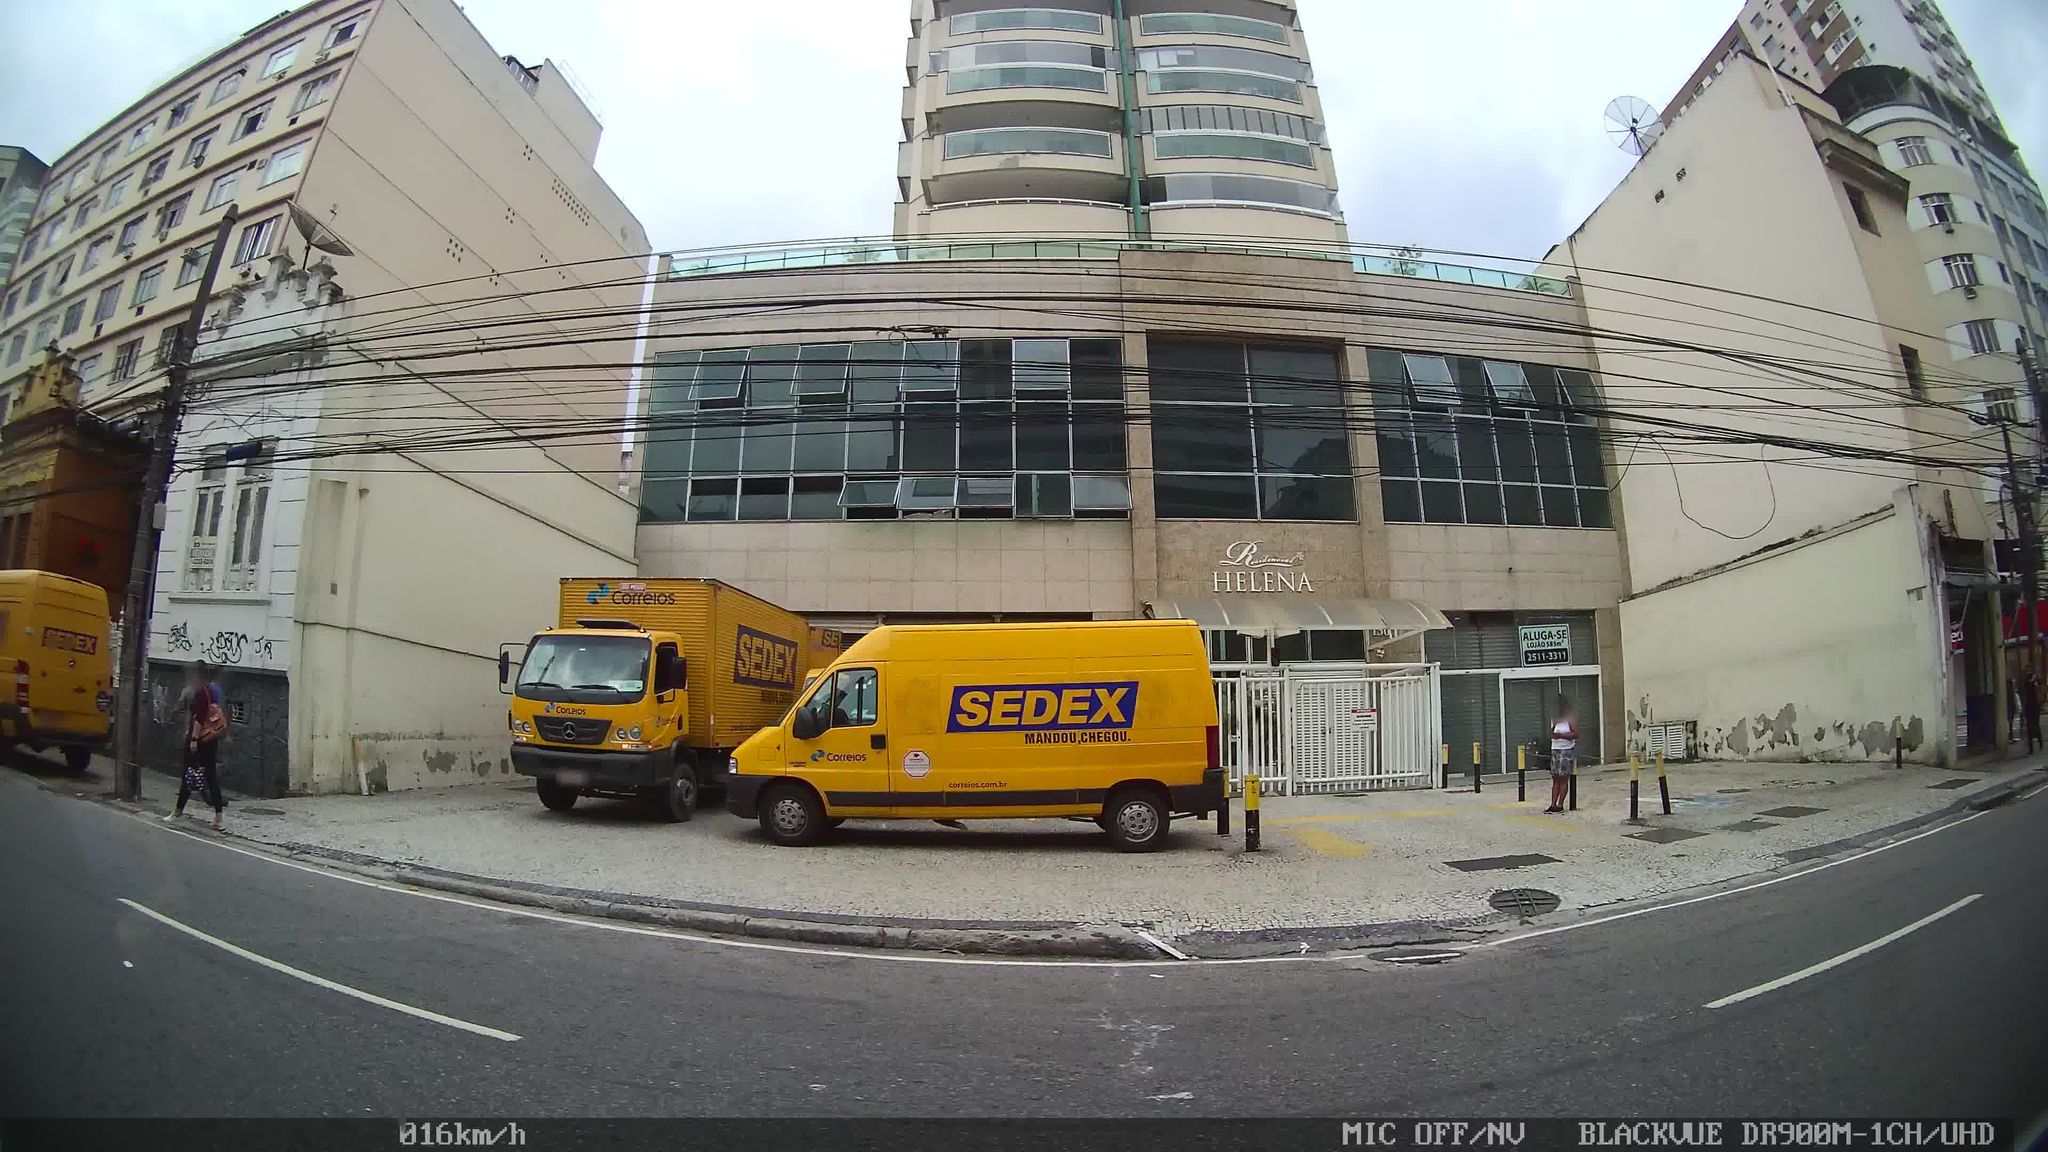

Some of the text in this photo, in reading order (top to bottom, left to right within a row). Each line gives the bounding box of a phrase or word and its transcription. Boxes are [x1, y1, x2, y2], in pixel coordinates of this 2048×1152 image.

[1212, 571, 1315, 593] HELENA
[612, 590, 677, 606] Correios
[1523, 630, 1567, 641] ALUGA-SE
[738, 632, 797, 684] SEDEX
[1527, 651, 1566, 662] 2511-3311
[955, 687, 1131, 727] SEDEX
[826, 752, 867, 762] Correios
[948, 781, 1008, 789] correios.com.br
